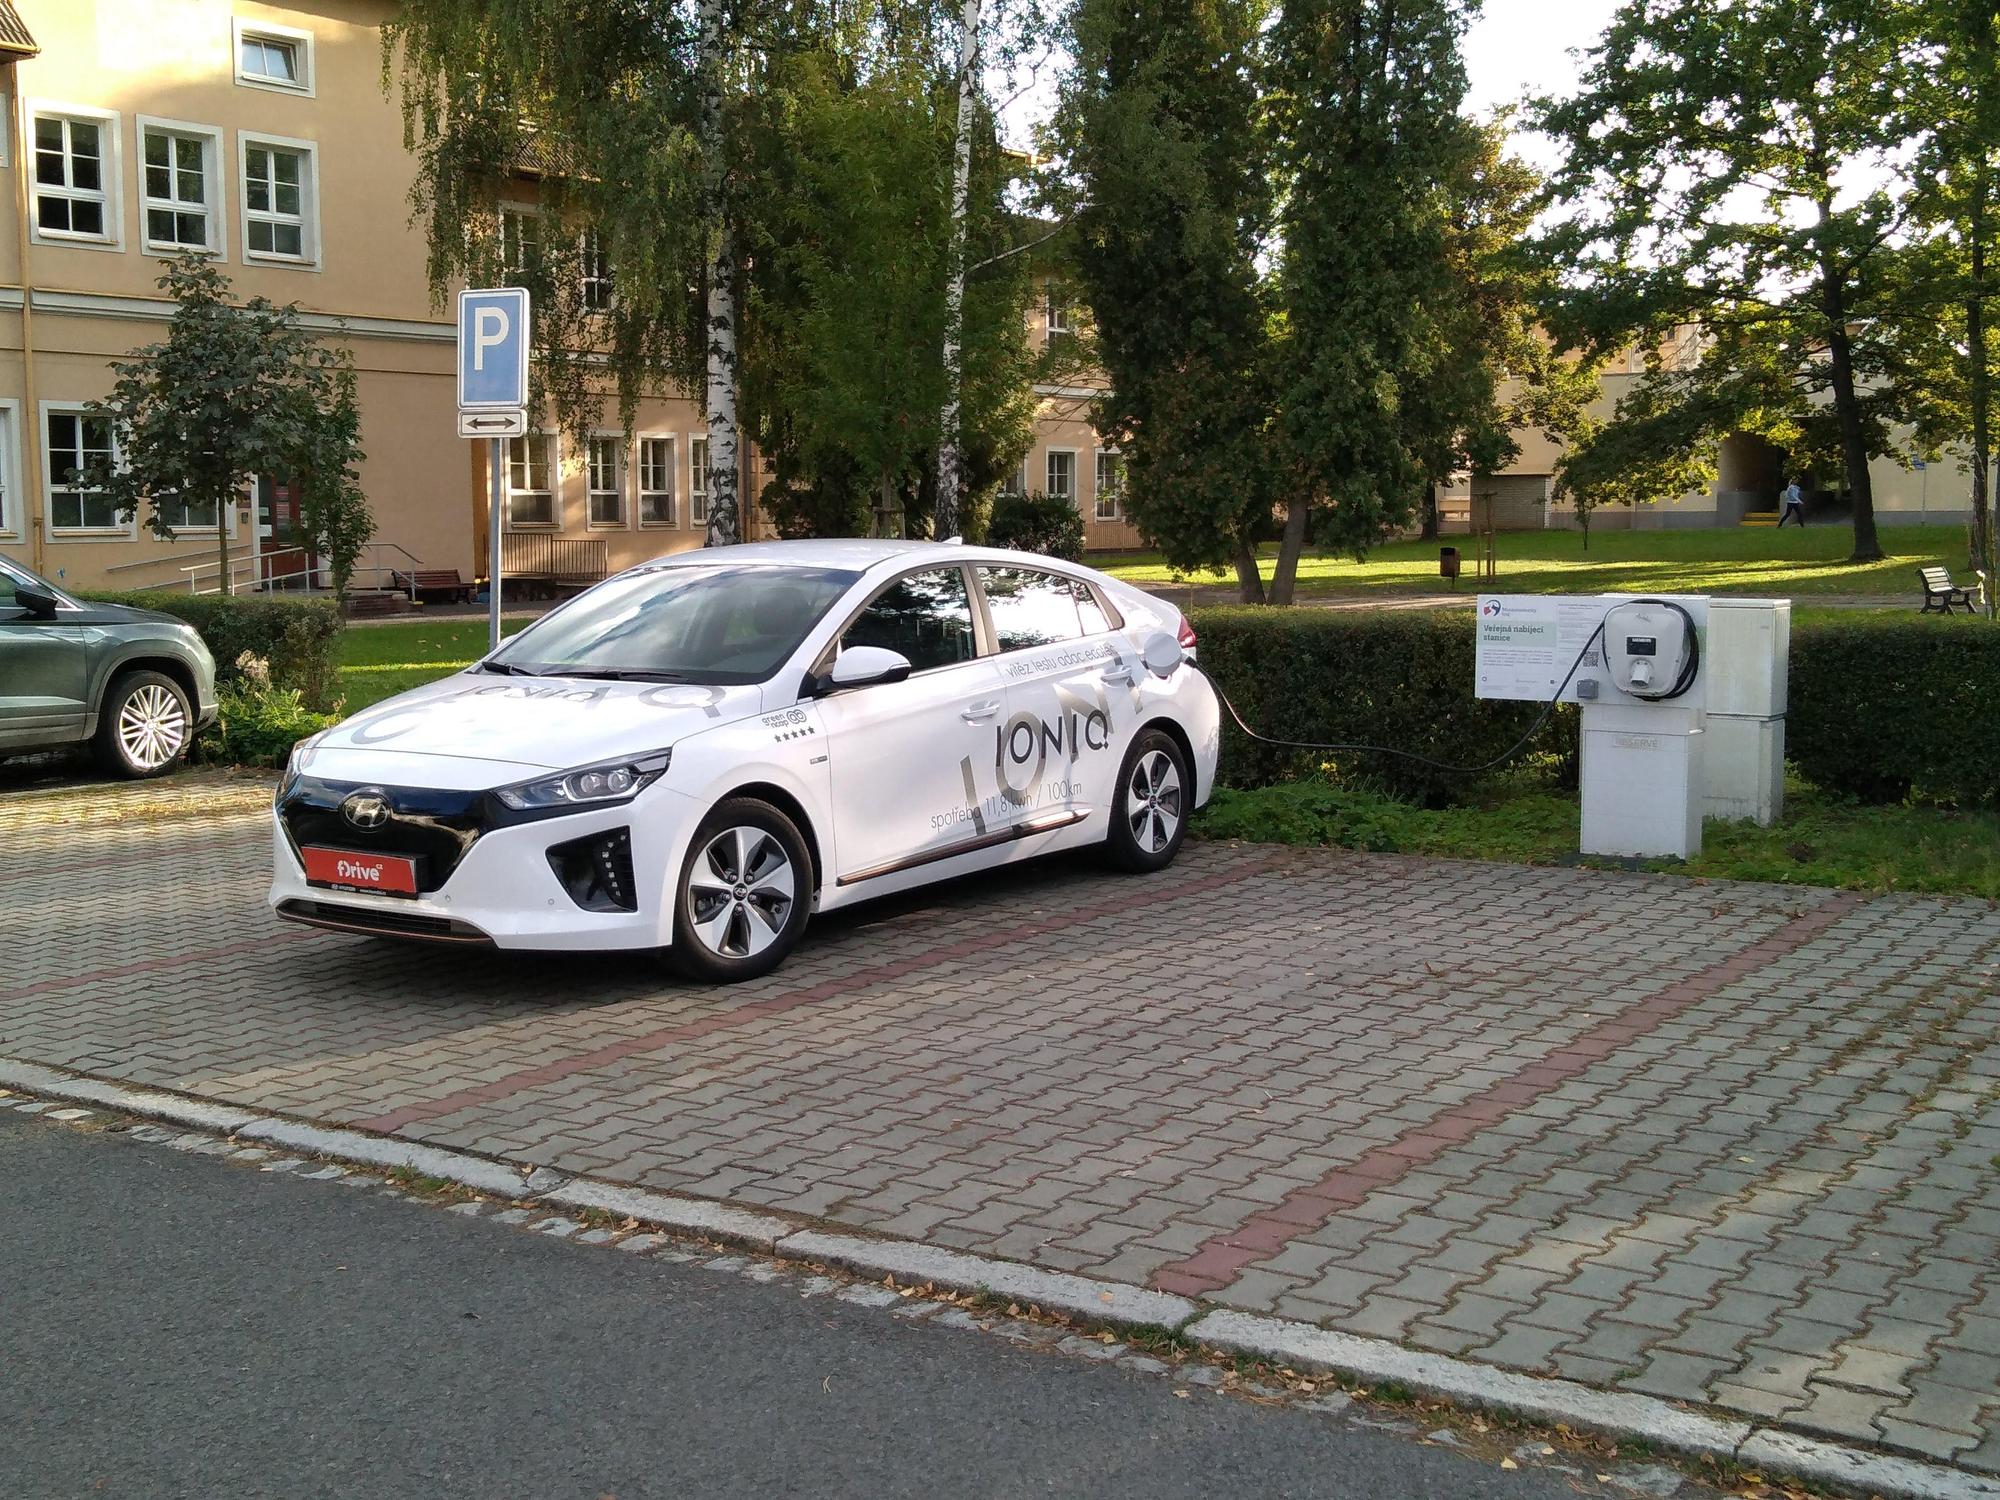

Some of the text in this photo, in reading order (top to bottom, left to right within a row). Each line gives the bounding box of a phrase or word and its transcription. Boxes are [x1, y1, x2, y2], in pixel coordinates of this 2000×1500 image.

[475, 308, 509, 370] P
[1483, 624, 1544, 635] Veřejná nabíjecí
[1483, 634, 1511, 642] stanice
[1057, 649, 1086, 666] adac
[762, 713, 786, 726] green
[770, 719, 789, 729] ncap
[996, 709, 1109, 767] IONIQ
[930, 801, 981, 833] spotřeba
[986, 795, 1008, 817] 11,8
[1048, 778, 1082, 801] 100km
